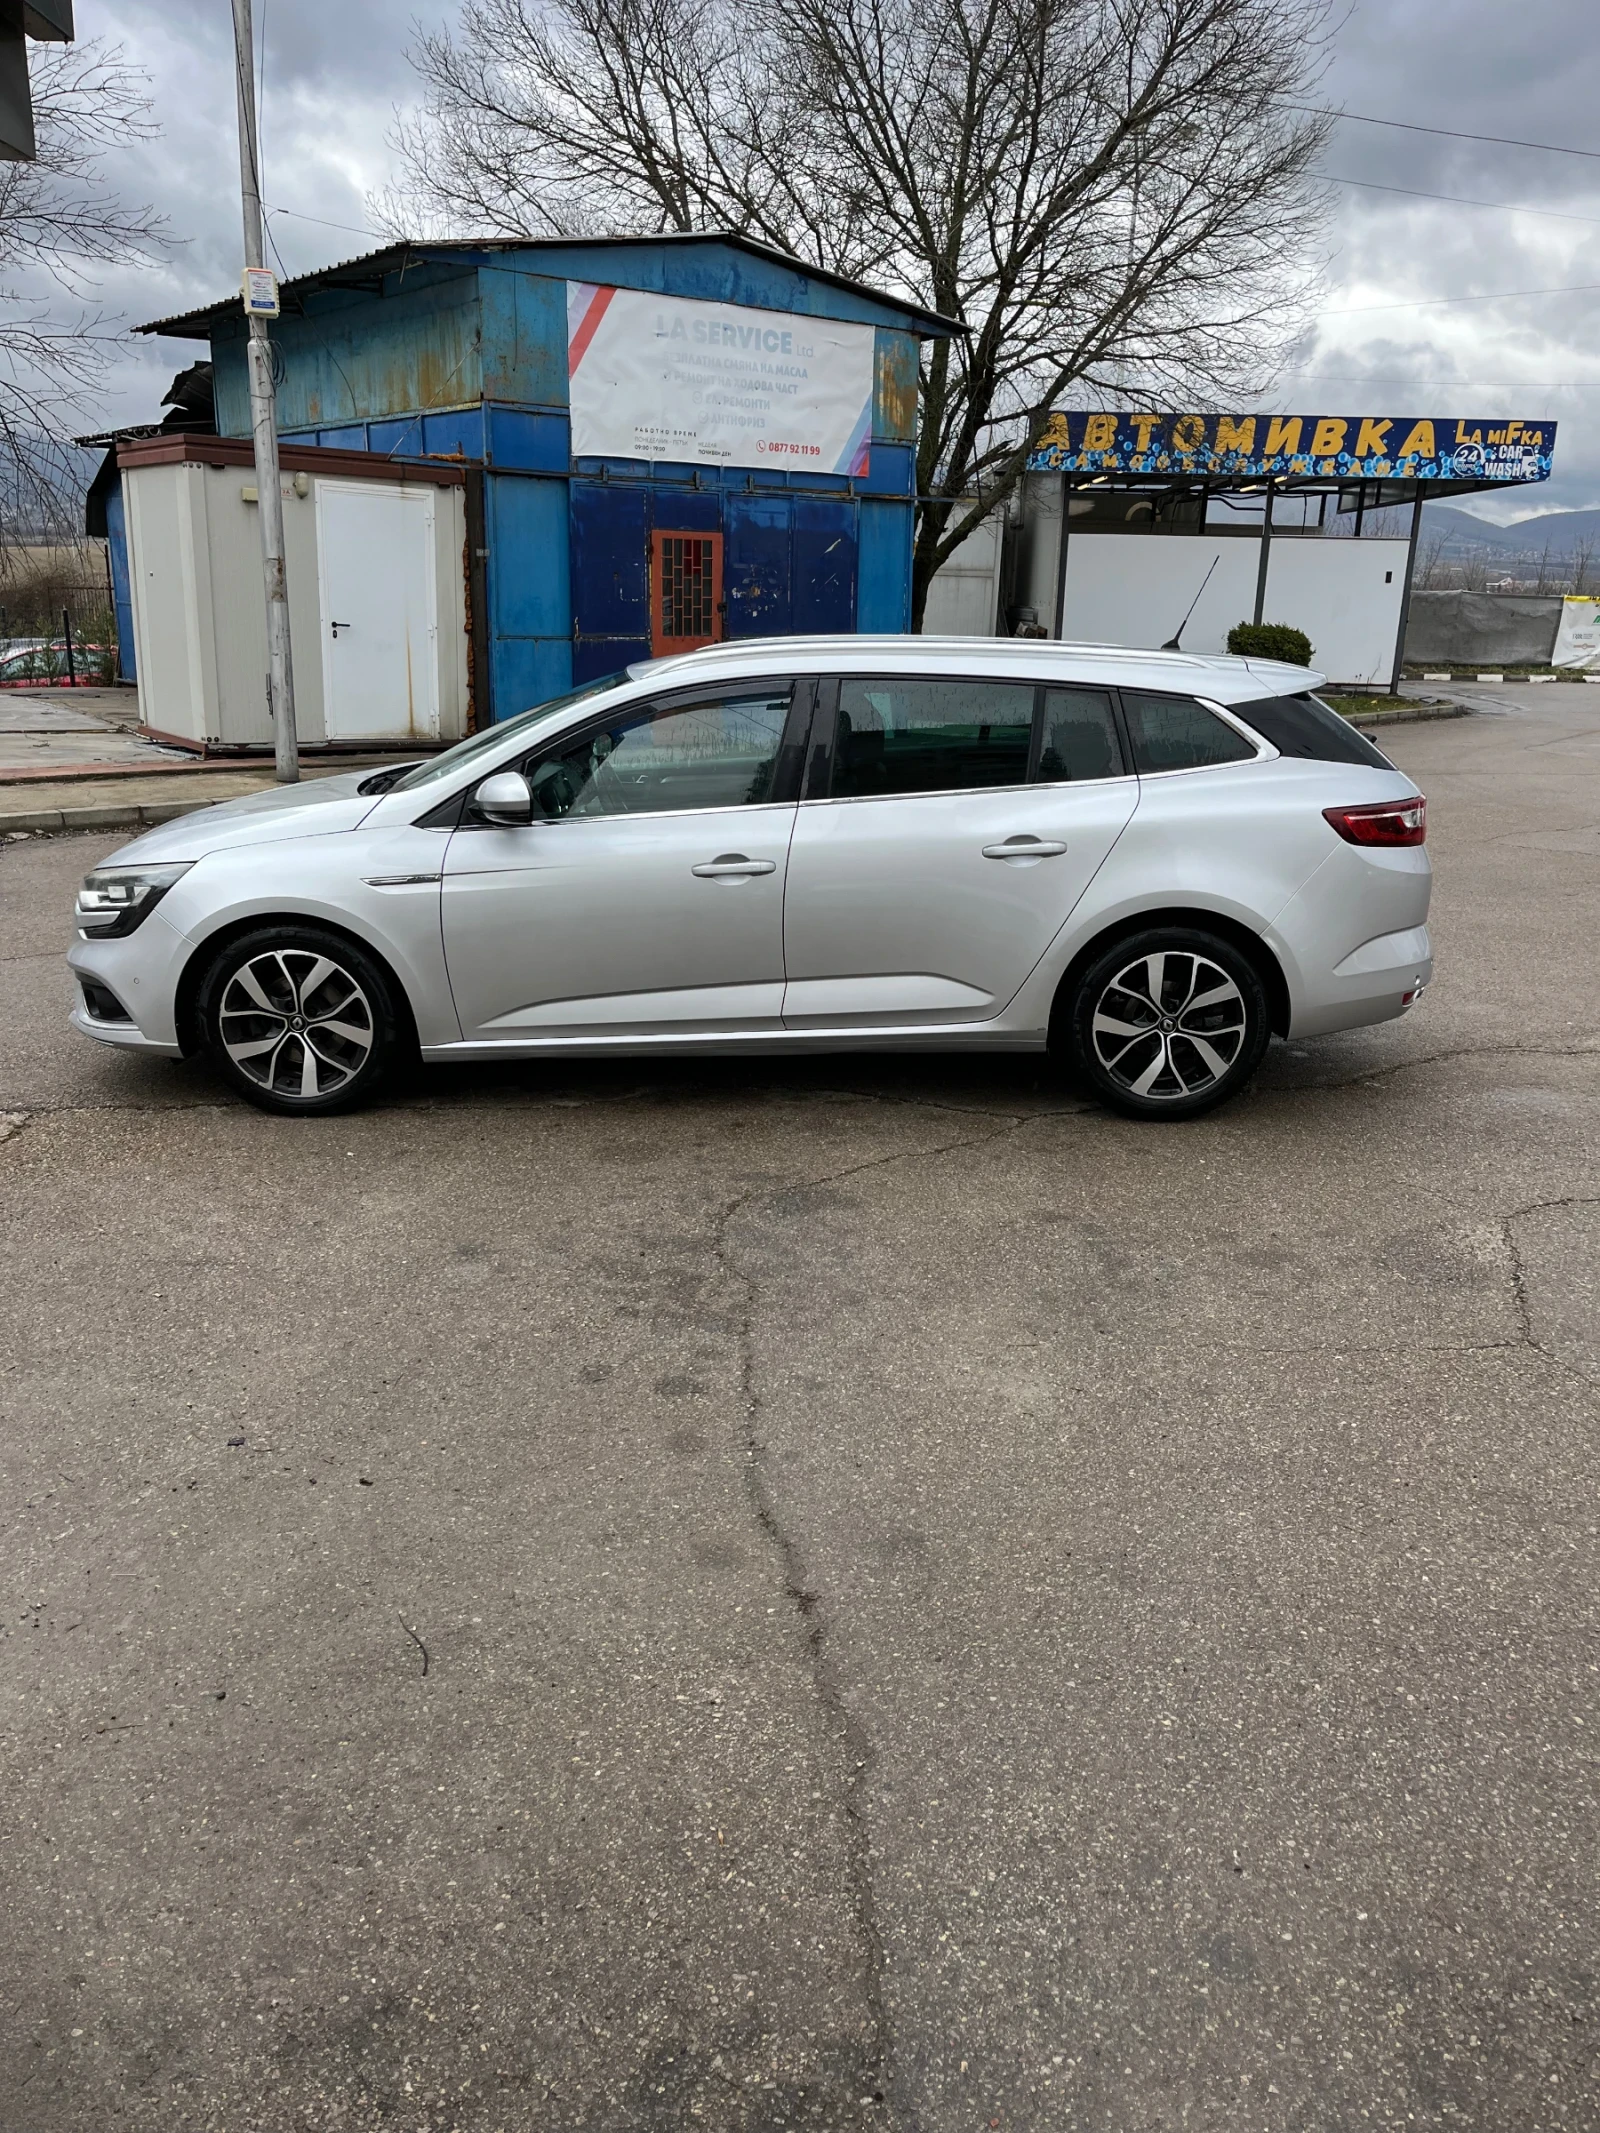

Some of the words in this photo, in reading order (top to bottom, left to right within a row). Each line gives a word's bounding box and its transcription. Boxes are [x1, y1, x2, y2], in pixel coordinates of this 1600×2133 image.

[653, 314, 689, 342] LA
[692, 318, 793, 355] SERVICE
[796, 344, 816, 358] Ltd.
[724, 357, 759, 373] СМЯНА
[760, 363, 774, 375] НА
[775, 364, 808, 379] МАСЛА
[674, 370, 716, 386] РЕМОНТ
[718, 375, 732, 388] НА
[734, 377, 774, 393] ХОДОВА
[775, 382, 799, 395] ЧАСТ
[722, 395, 771, 410] РЕМОНТИ
[710, 411, 766, 429] АНТИФРИЗ
[634, 426, 670, 436] РАБОТНО
[673, 429, 697, 438] ВРЕМЕ
[1034, 412, 1435, 460] АВТОМИВКА
[768, 441, 788, 454] 0877
[789, 444, 800, 455] 92
[801, 445, 808, 455] 11
[809, 446, 821, 456] 99
[1459, 449, 1479, 462] 24
[1499, 445, 1524, 460] CAR
[1484, 462, 1521, 477] WASH
